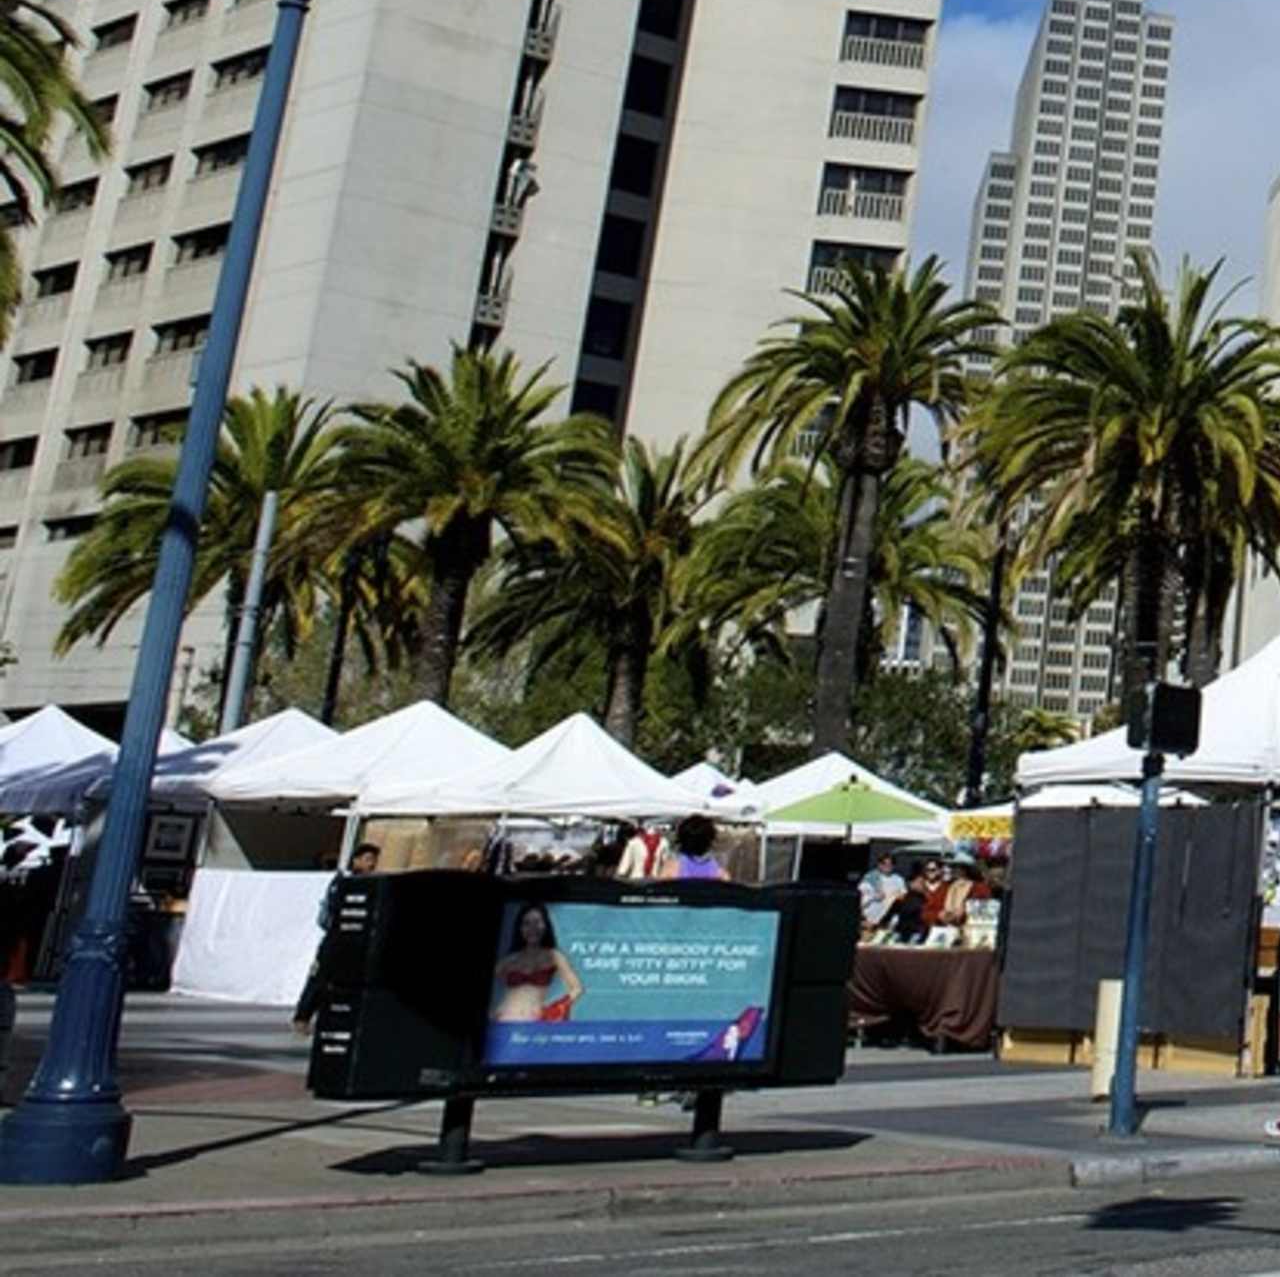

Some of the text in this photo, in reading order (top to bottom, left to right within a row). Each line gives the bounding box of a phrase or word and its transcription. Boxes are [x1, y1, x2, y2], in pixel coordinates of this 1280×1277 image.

[570, 941, 598, 954] FLY
[600, 942, 616, 954] IN
[619, 942, 631, 955] A
[584, 957, 620, 970] SAVE
[716, 957, 748, 971] FOR
[619, 973, 660, 986] YOUR
